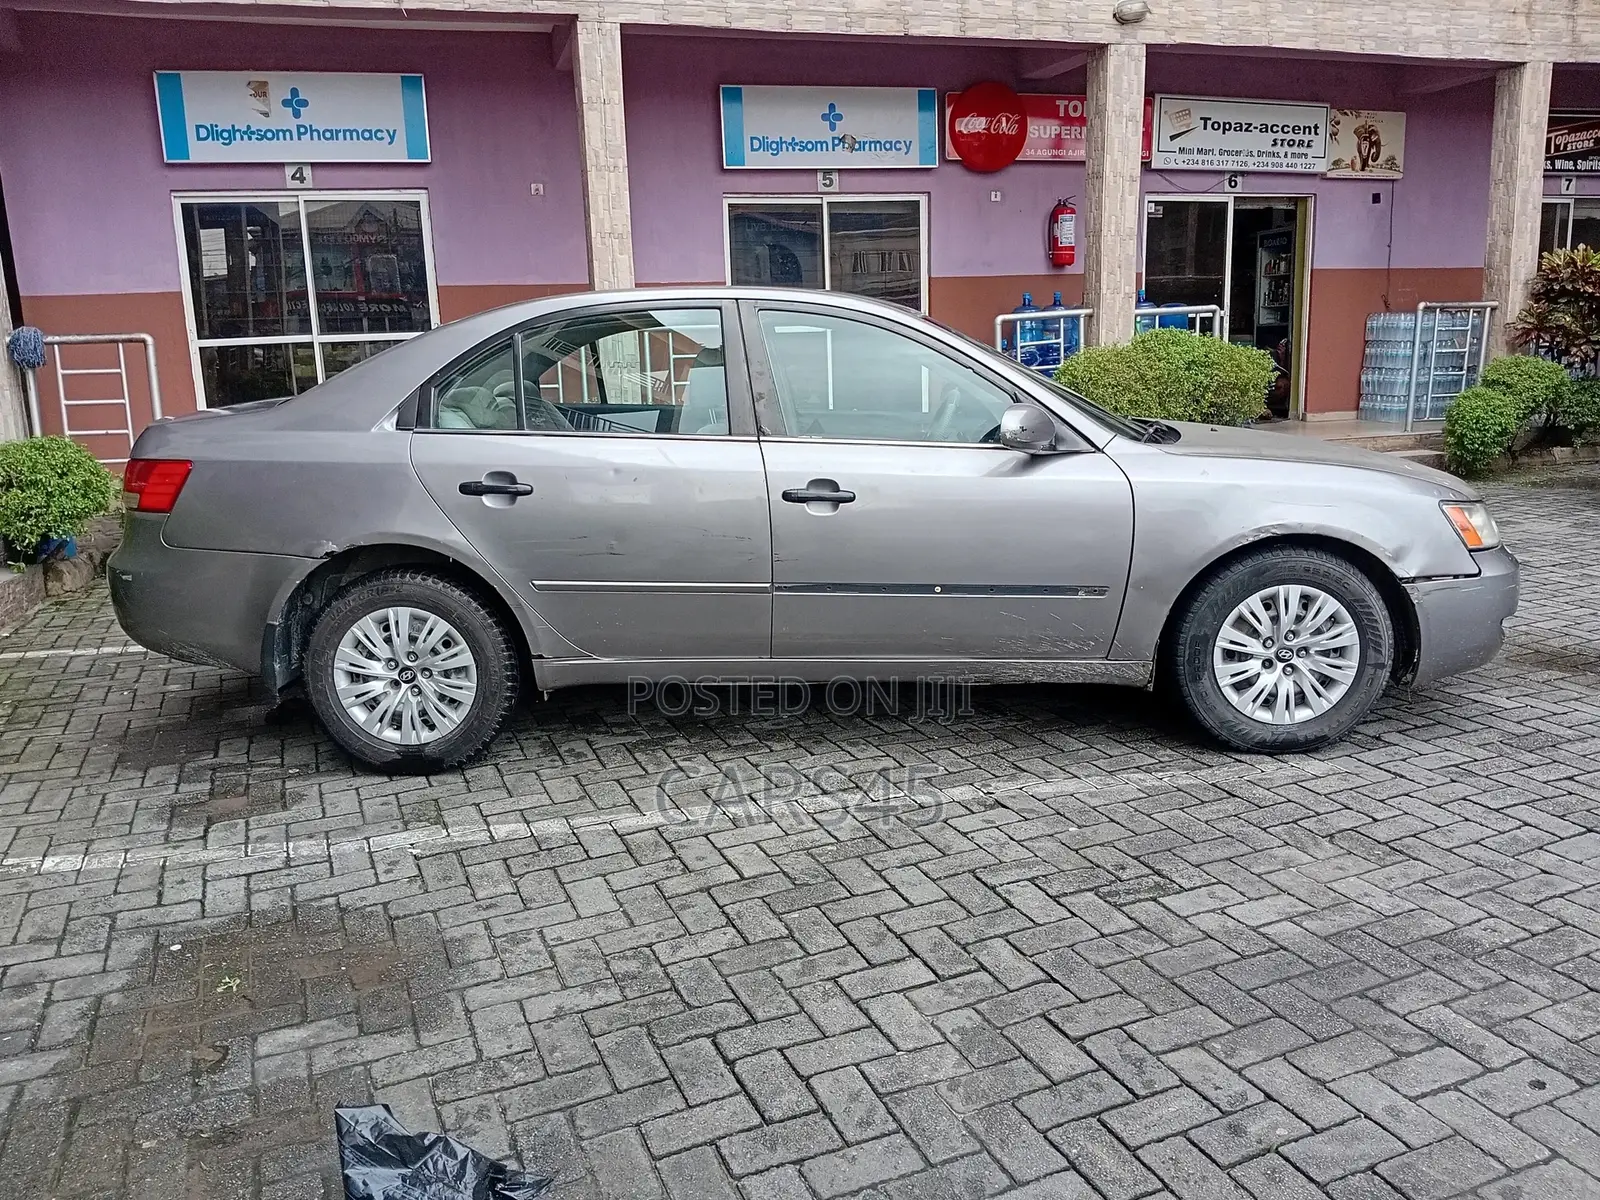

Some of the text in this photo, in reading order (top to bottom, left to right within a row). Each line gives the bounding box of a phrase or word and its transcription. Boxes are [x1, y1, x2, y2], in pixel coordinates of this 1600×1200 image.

[1056, 100, 1087, 117] TO
[960, 112, 1021, 135] Coca-Cola
[1200, 117, 1320, 136] Topaz-accent
[296, 124, 397, 146] Pharmacy
[1029, 125, 1087, 139] SUPER
[1178, 147, 1194, 155] Mini
[1271, 138, 1314, 148] STORE
[1566, 139, 1595, 151] STORE
[1555, 159, 1575, 170] Wine,
[291, 167, 306, 184] 4
[822, 171, 834, 188] 5
[1228, 173, 1238, 189] 6
[1565, 178, 1573, 191] 7
